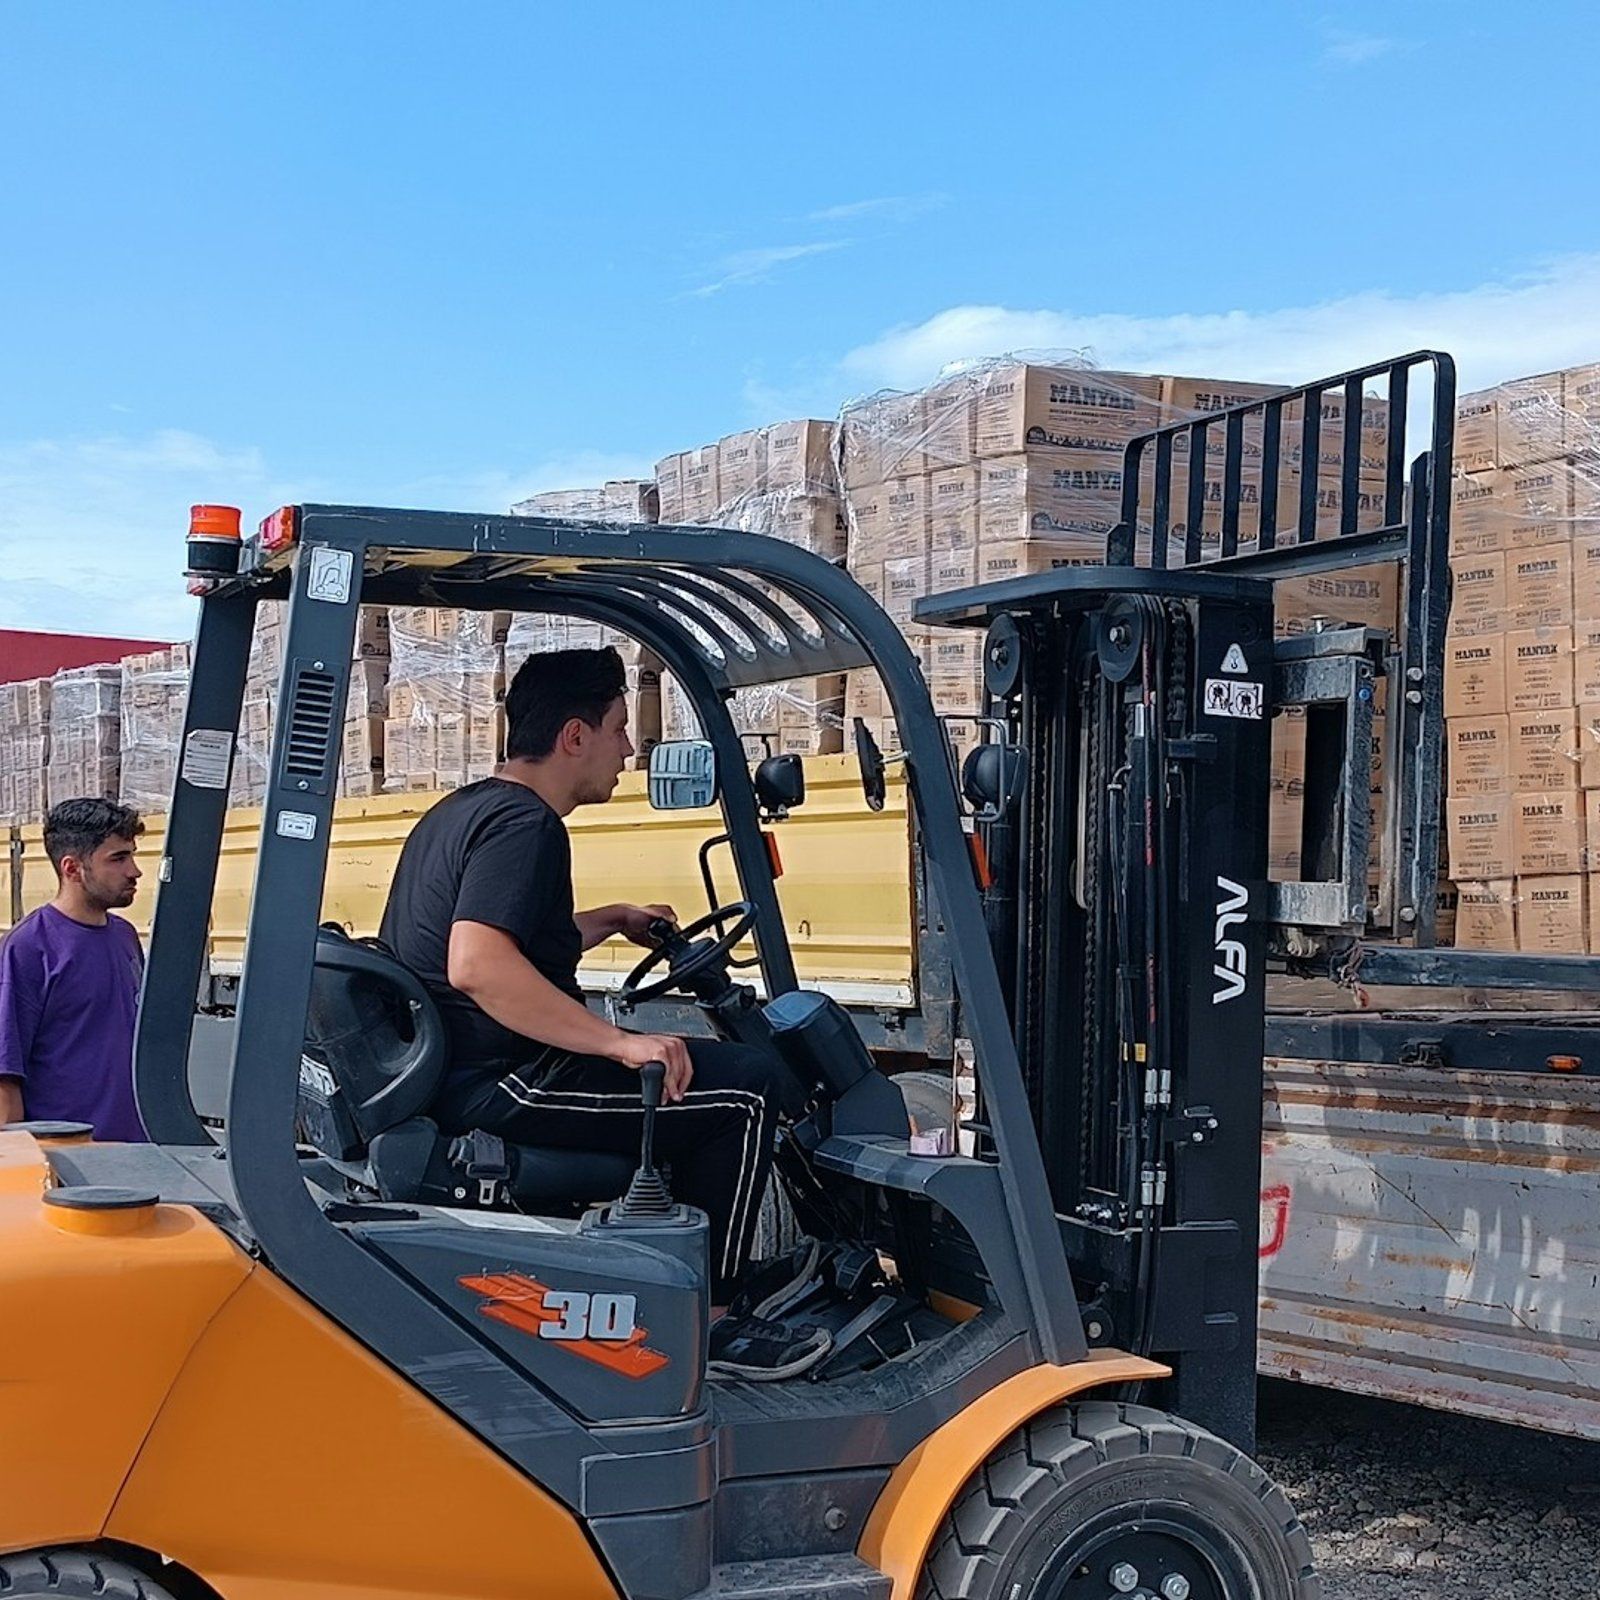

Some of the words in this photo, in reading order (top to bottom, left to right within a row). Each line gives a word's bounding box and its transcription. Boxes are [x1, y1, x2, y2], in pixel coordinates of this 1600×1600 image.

[1050, 384, 1135, 410] MANYAK
[1052, 470, 1121, 490] MANYA
[1517, 560, 1558, 574] MANYAK
[1457, 569, 1495, 583] MANYAK
[1307, 578, 1381, 598] MANYAK
[1455, 647, 1491, 660] MANYAK
[1516, 643, 1558, 657] MANYAK
[1458, 730, 1496, 742] MANYAK
[1520, 724, 1561, 736] MANYAK
[1522, 804, 1563, 816] MANYAK
[1459, 813, 1497, 825] MANYAK
[1462, 893, 1500, 904] MANYAK
[1531, 890, 1570, 901] MANYAK
[1213, 876, 1249, 1004] ALFA
[539, 1290, 637, 1340] 30
